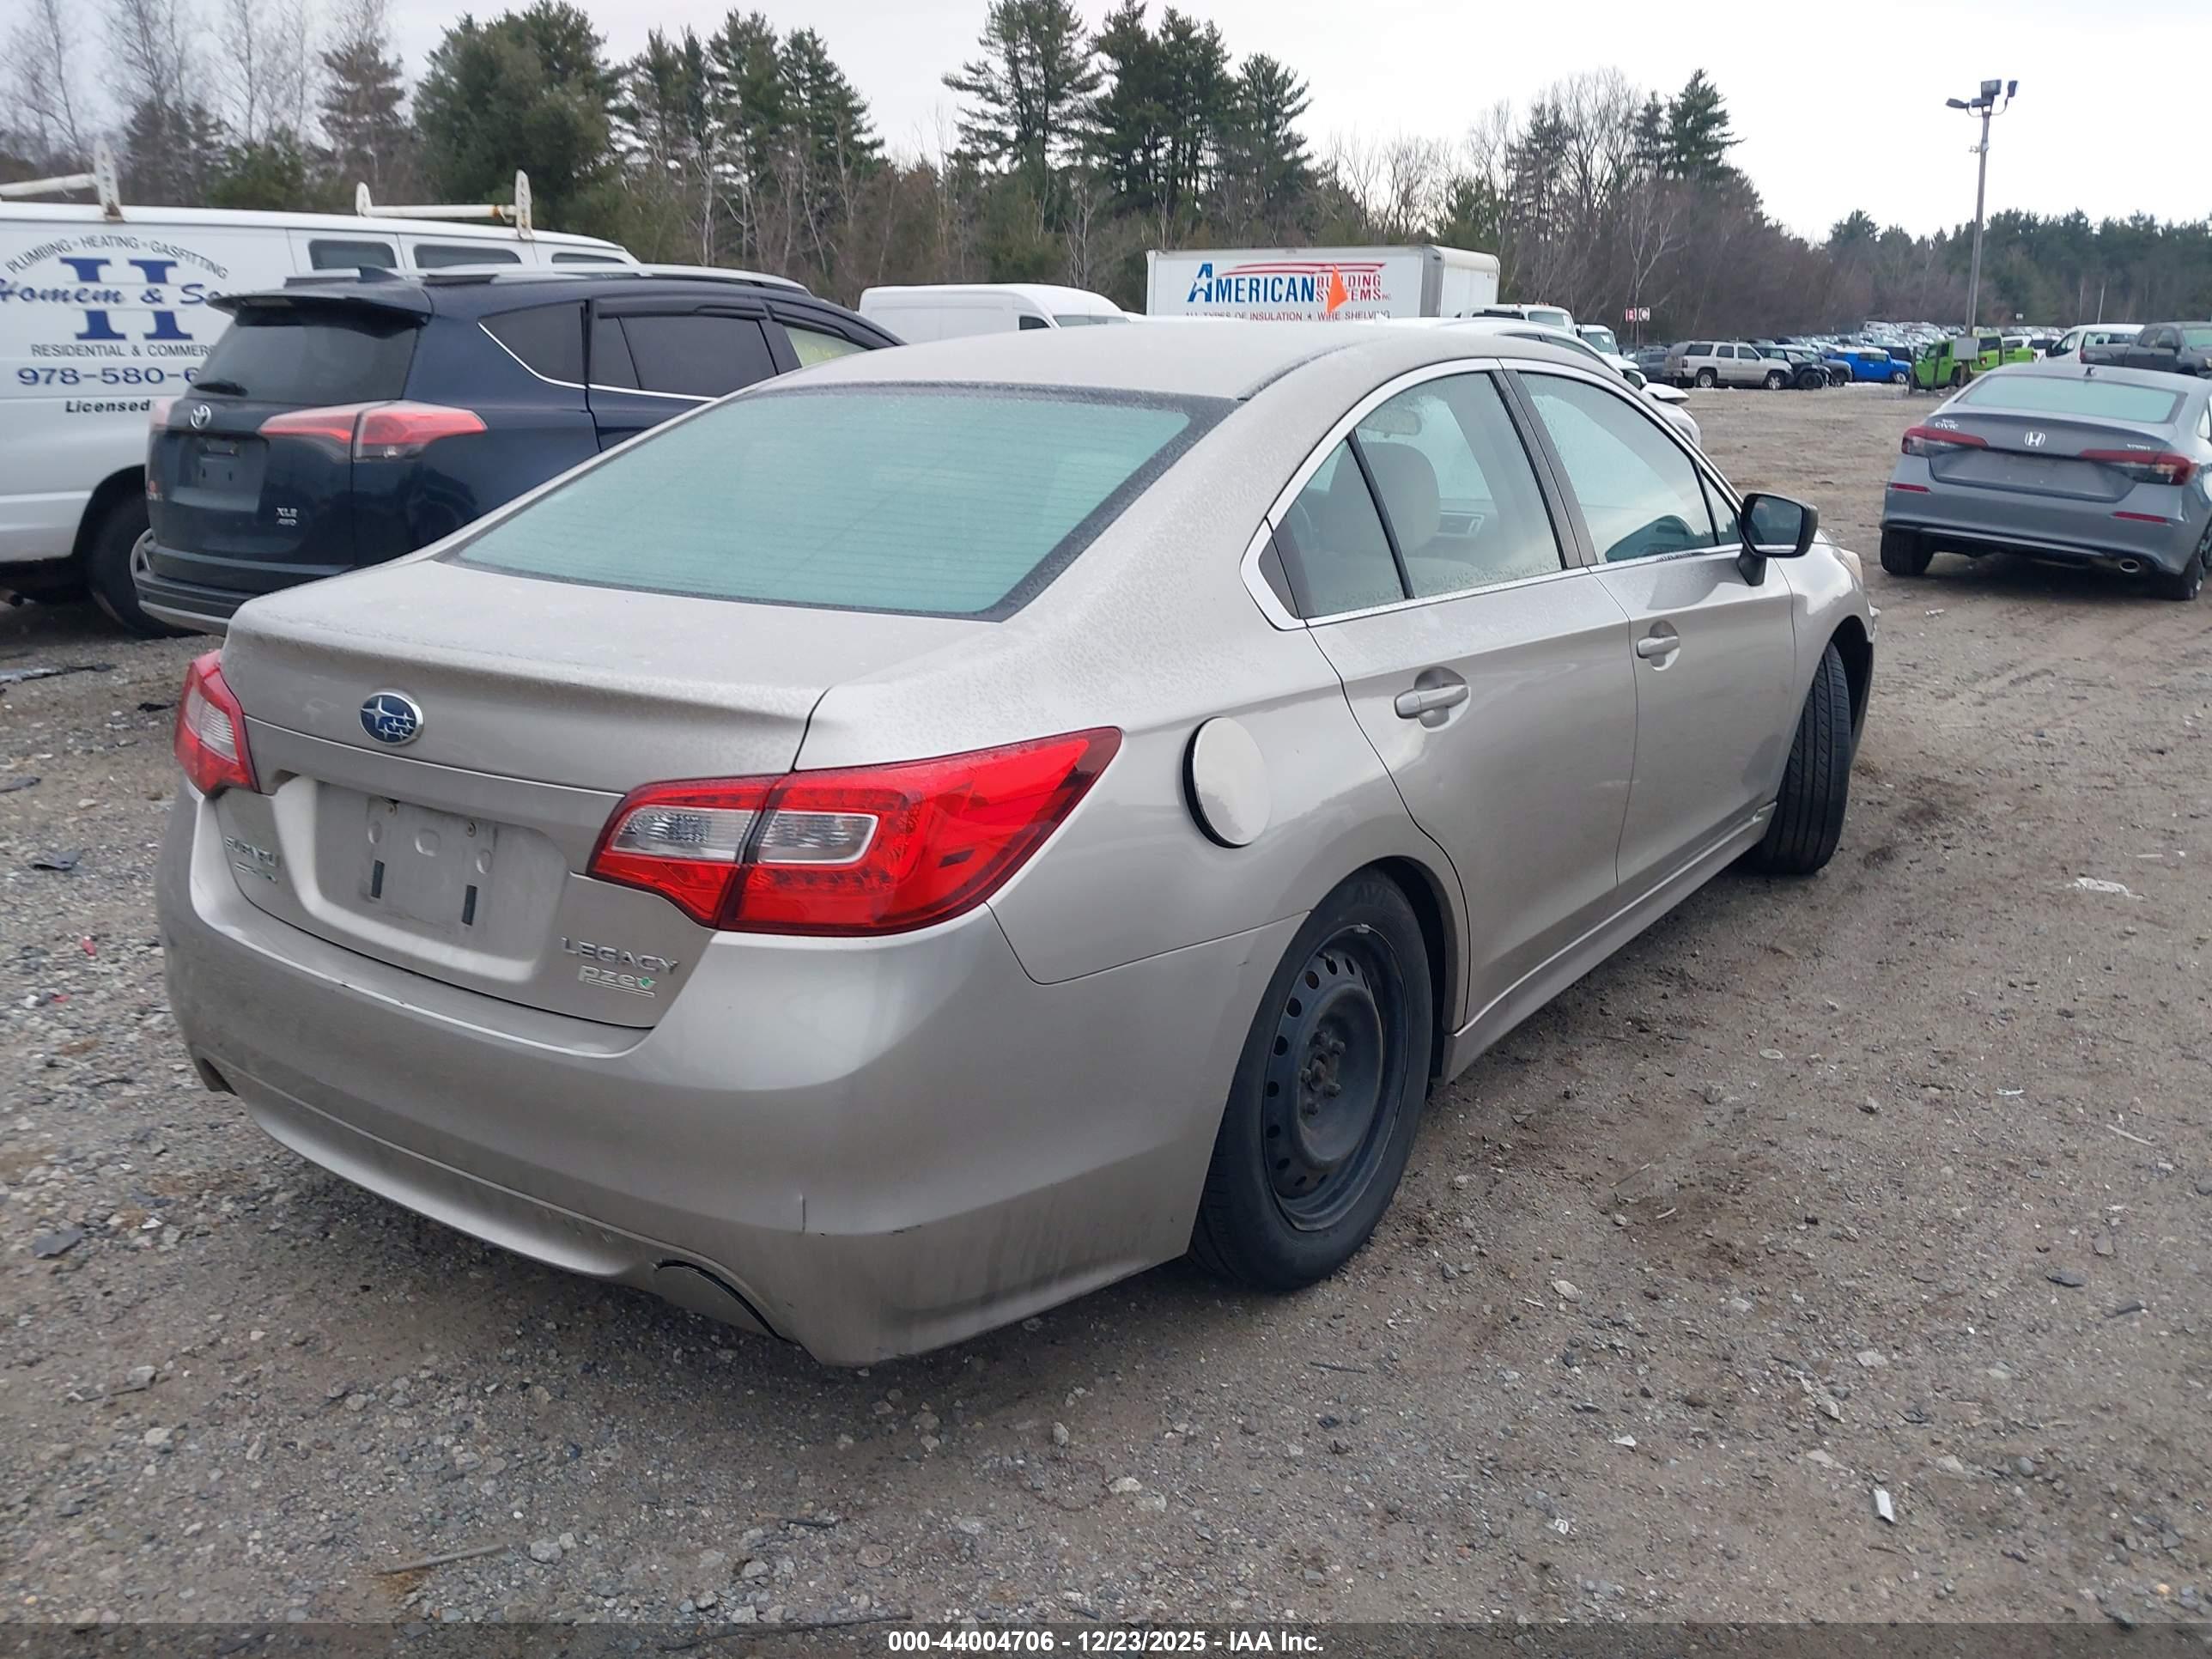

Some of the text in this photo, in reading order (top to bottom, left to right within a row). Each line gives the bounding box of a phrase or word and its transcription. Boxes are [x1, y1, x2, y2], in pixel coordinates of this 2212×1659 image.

[5, 234, 228, 279] PLUMBING HEATING GASFITTING
[1187, 263, 1316, 303] AMERICAN
[1316, 274, 1382, 288] BUDING
[140, 288, 163, 304] &
[1316, 288, 1381, 302] SYEMS
[1250, 311, 1303, 321] INSULATION
[31, 343, 211, 357] RESIDENTIAL & COMMER
[65, 399, 150, 413] Licensed
[561, 936, 680, 975] LEGACY
